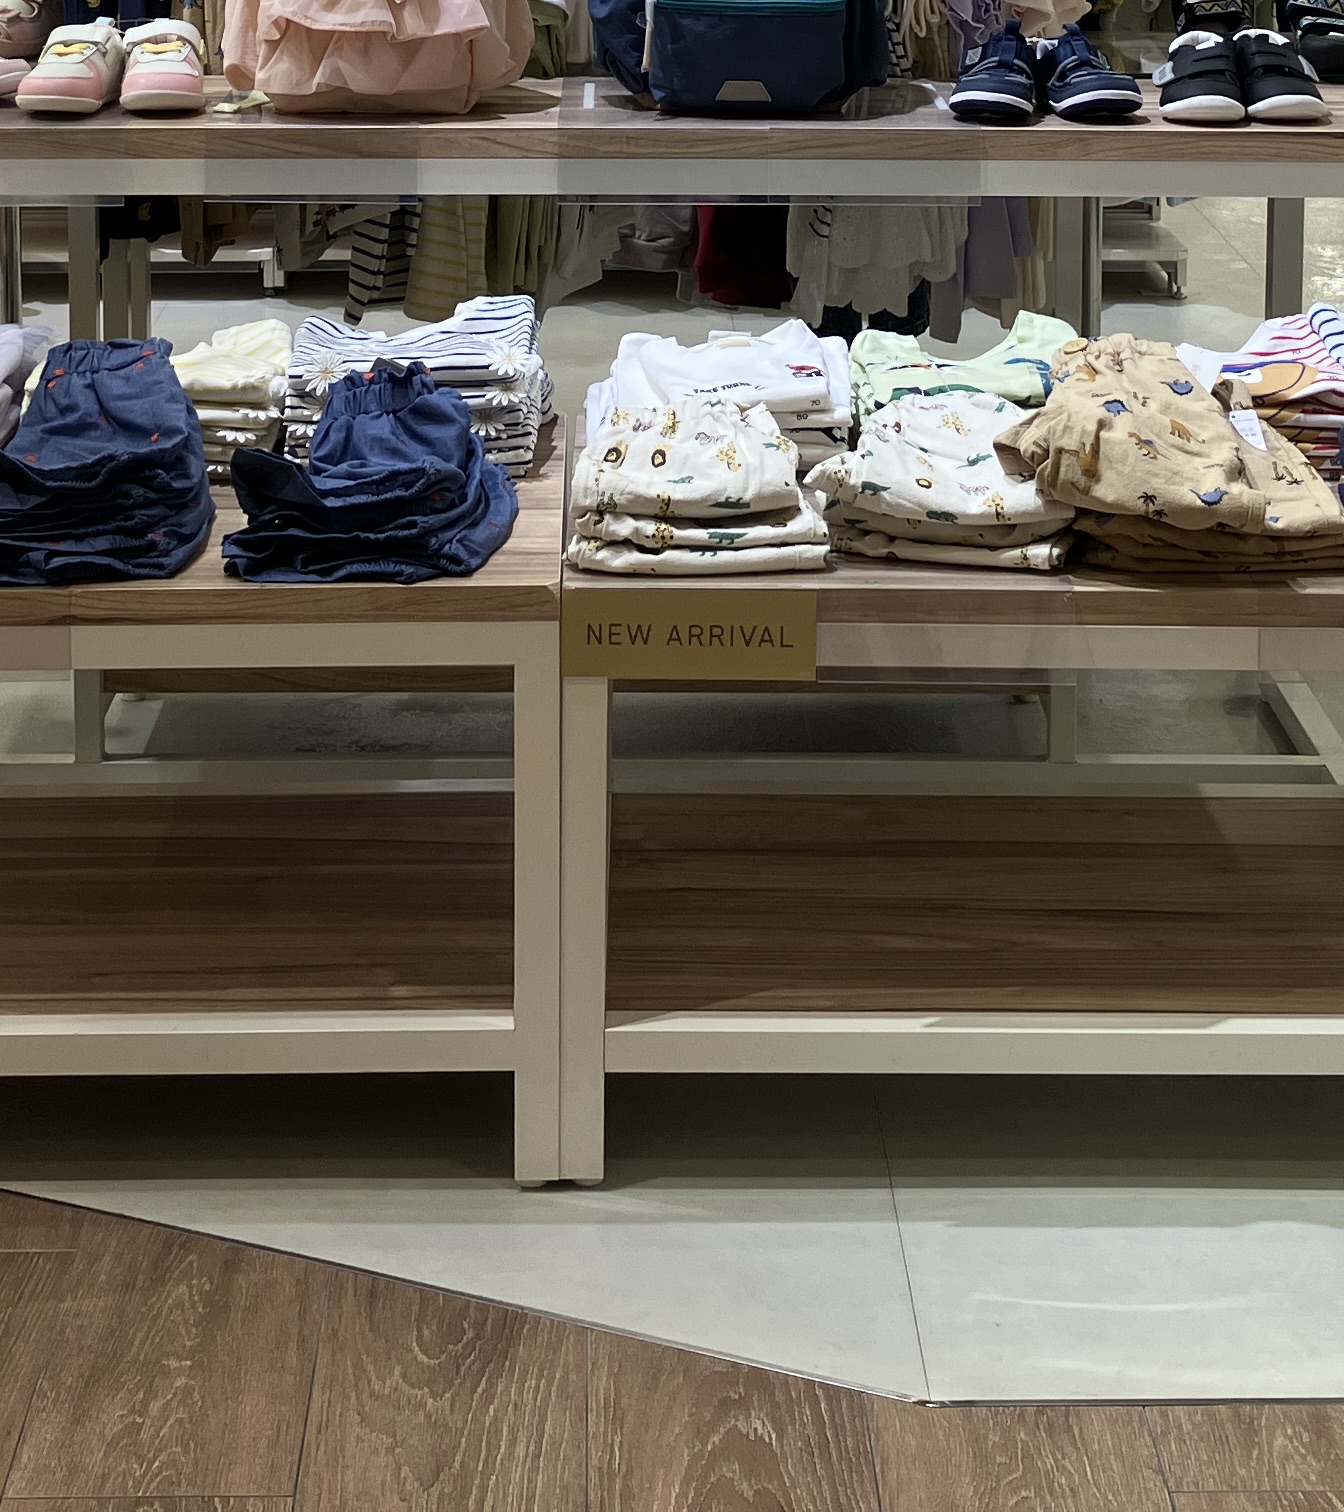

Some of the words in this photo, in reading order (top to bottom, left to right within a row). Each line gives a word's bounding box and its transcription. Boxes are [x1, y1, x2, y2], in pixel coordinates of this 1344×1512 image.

[809, 399, 821, 407] 70
[586, 623, 653, 646] NEW
[666, 624, 794, 648] ARRIVAL
